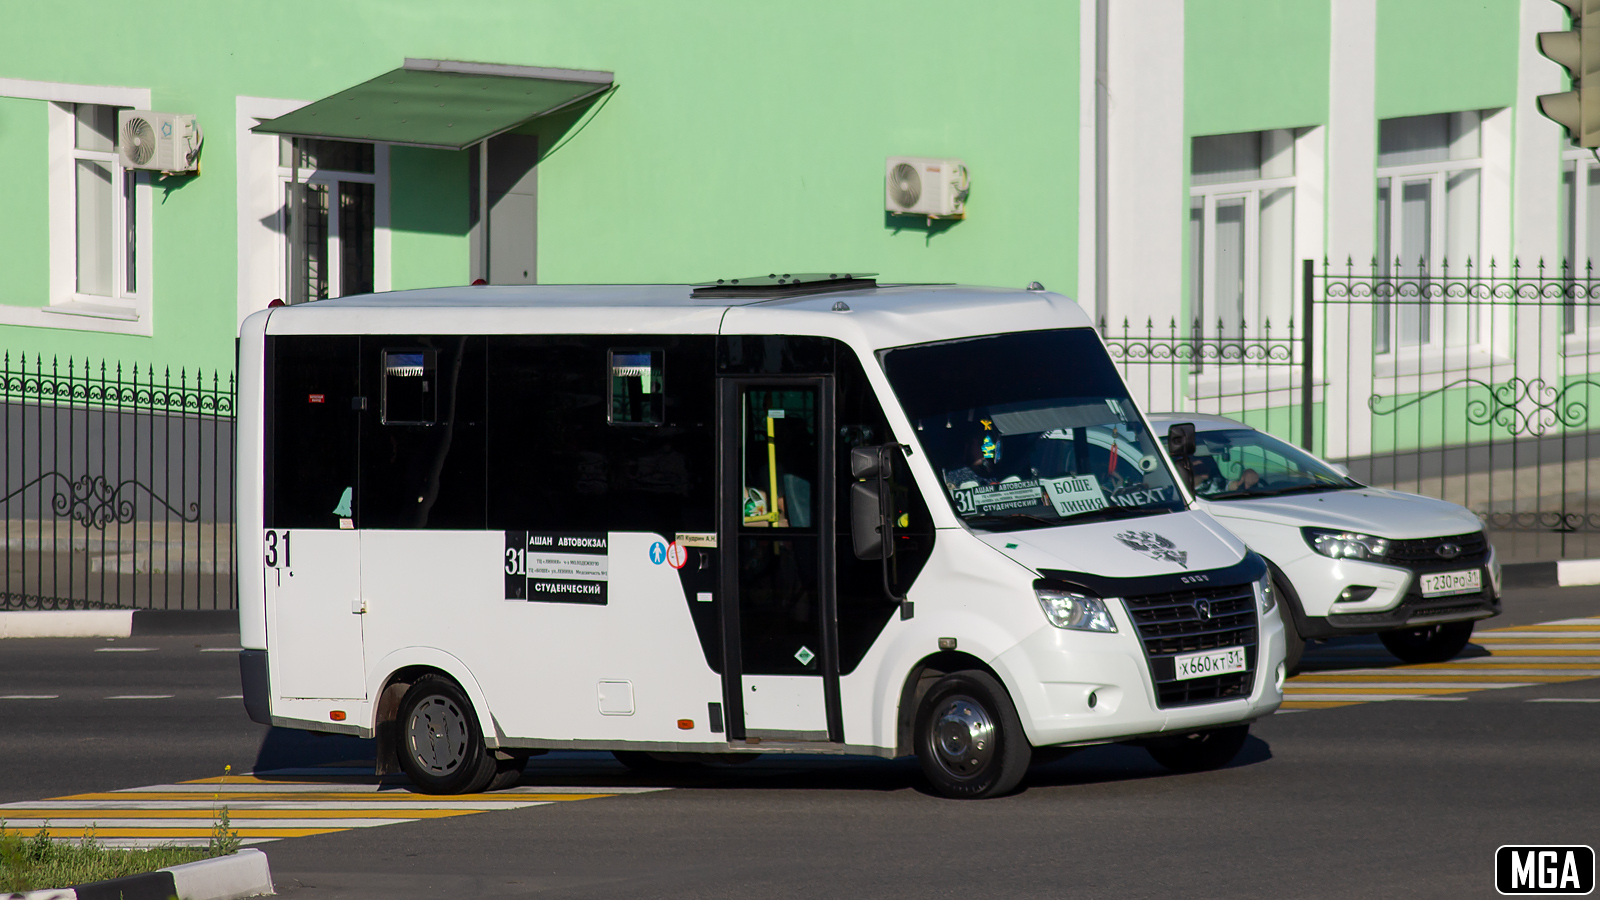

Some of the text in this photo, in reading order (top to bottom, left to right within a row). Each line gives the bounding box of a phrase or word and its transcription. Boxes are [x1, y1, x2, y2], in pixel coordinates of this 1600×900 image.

[975, 486, 994, 494] АШАН
[998, 479, 1039, 491] АВТОВОКЗАЛ
[1053, 479, 1093, 494] БОШЕ
[955, 490, 975, 513] 31
[1117, 487, 1166, 507] NEXT
[983, 499, 1037, 512] СТУДЕНЧЕСКИЙ
[1060, 497, 1104, 513] ЛИНИЯ
[265, 530, 291, 568] 31
[529, 536, 607, 547] АШАН АВТОВОКЗАЛ
[505, 547, 526, 575] 31
[535, 582, 601, 594] СТУДЕНЧЕСКИЙ
[1228, 650, 1240, 664] 31
